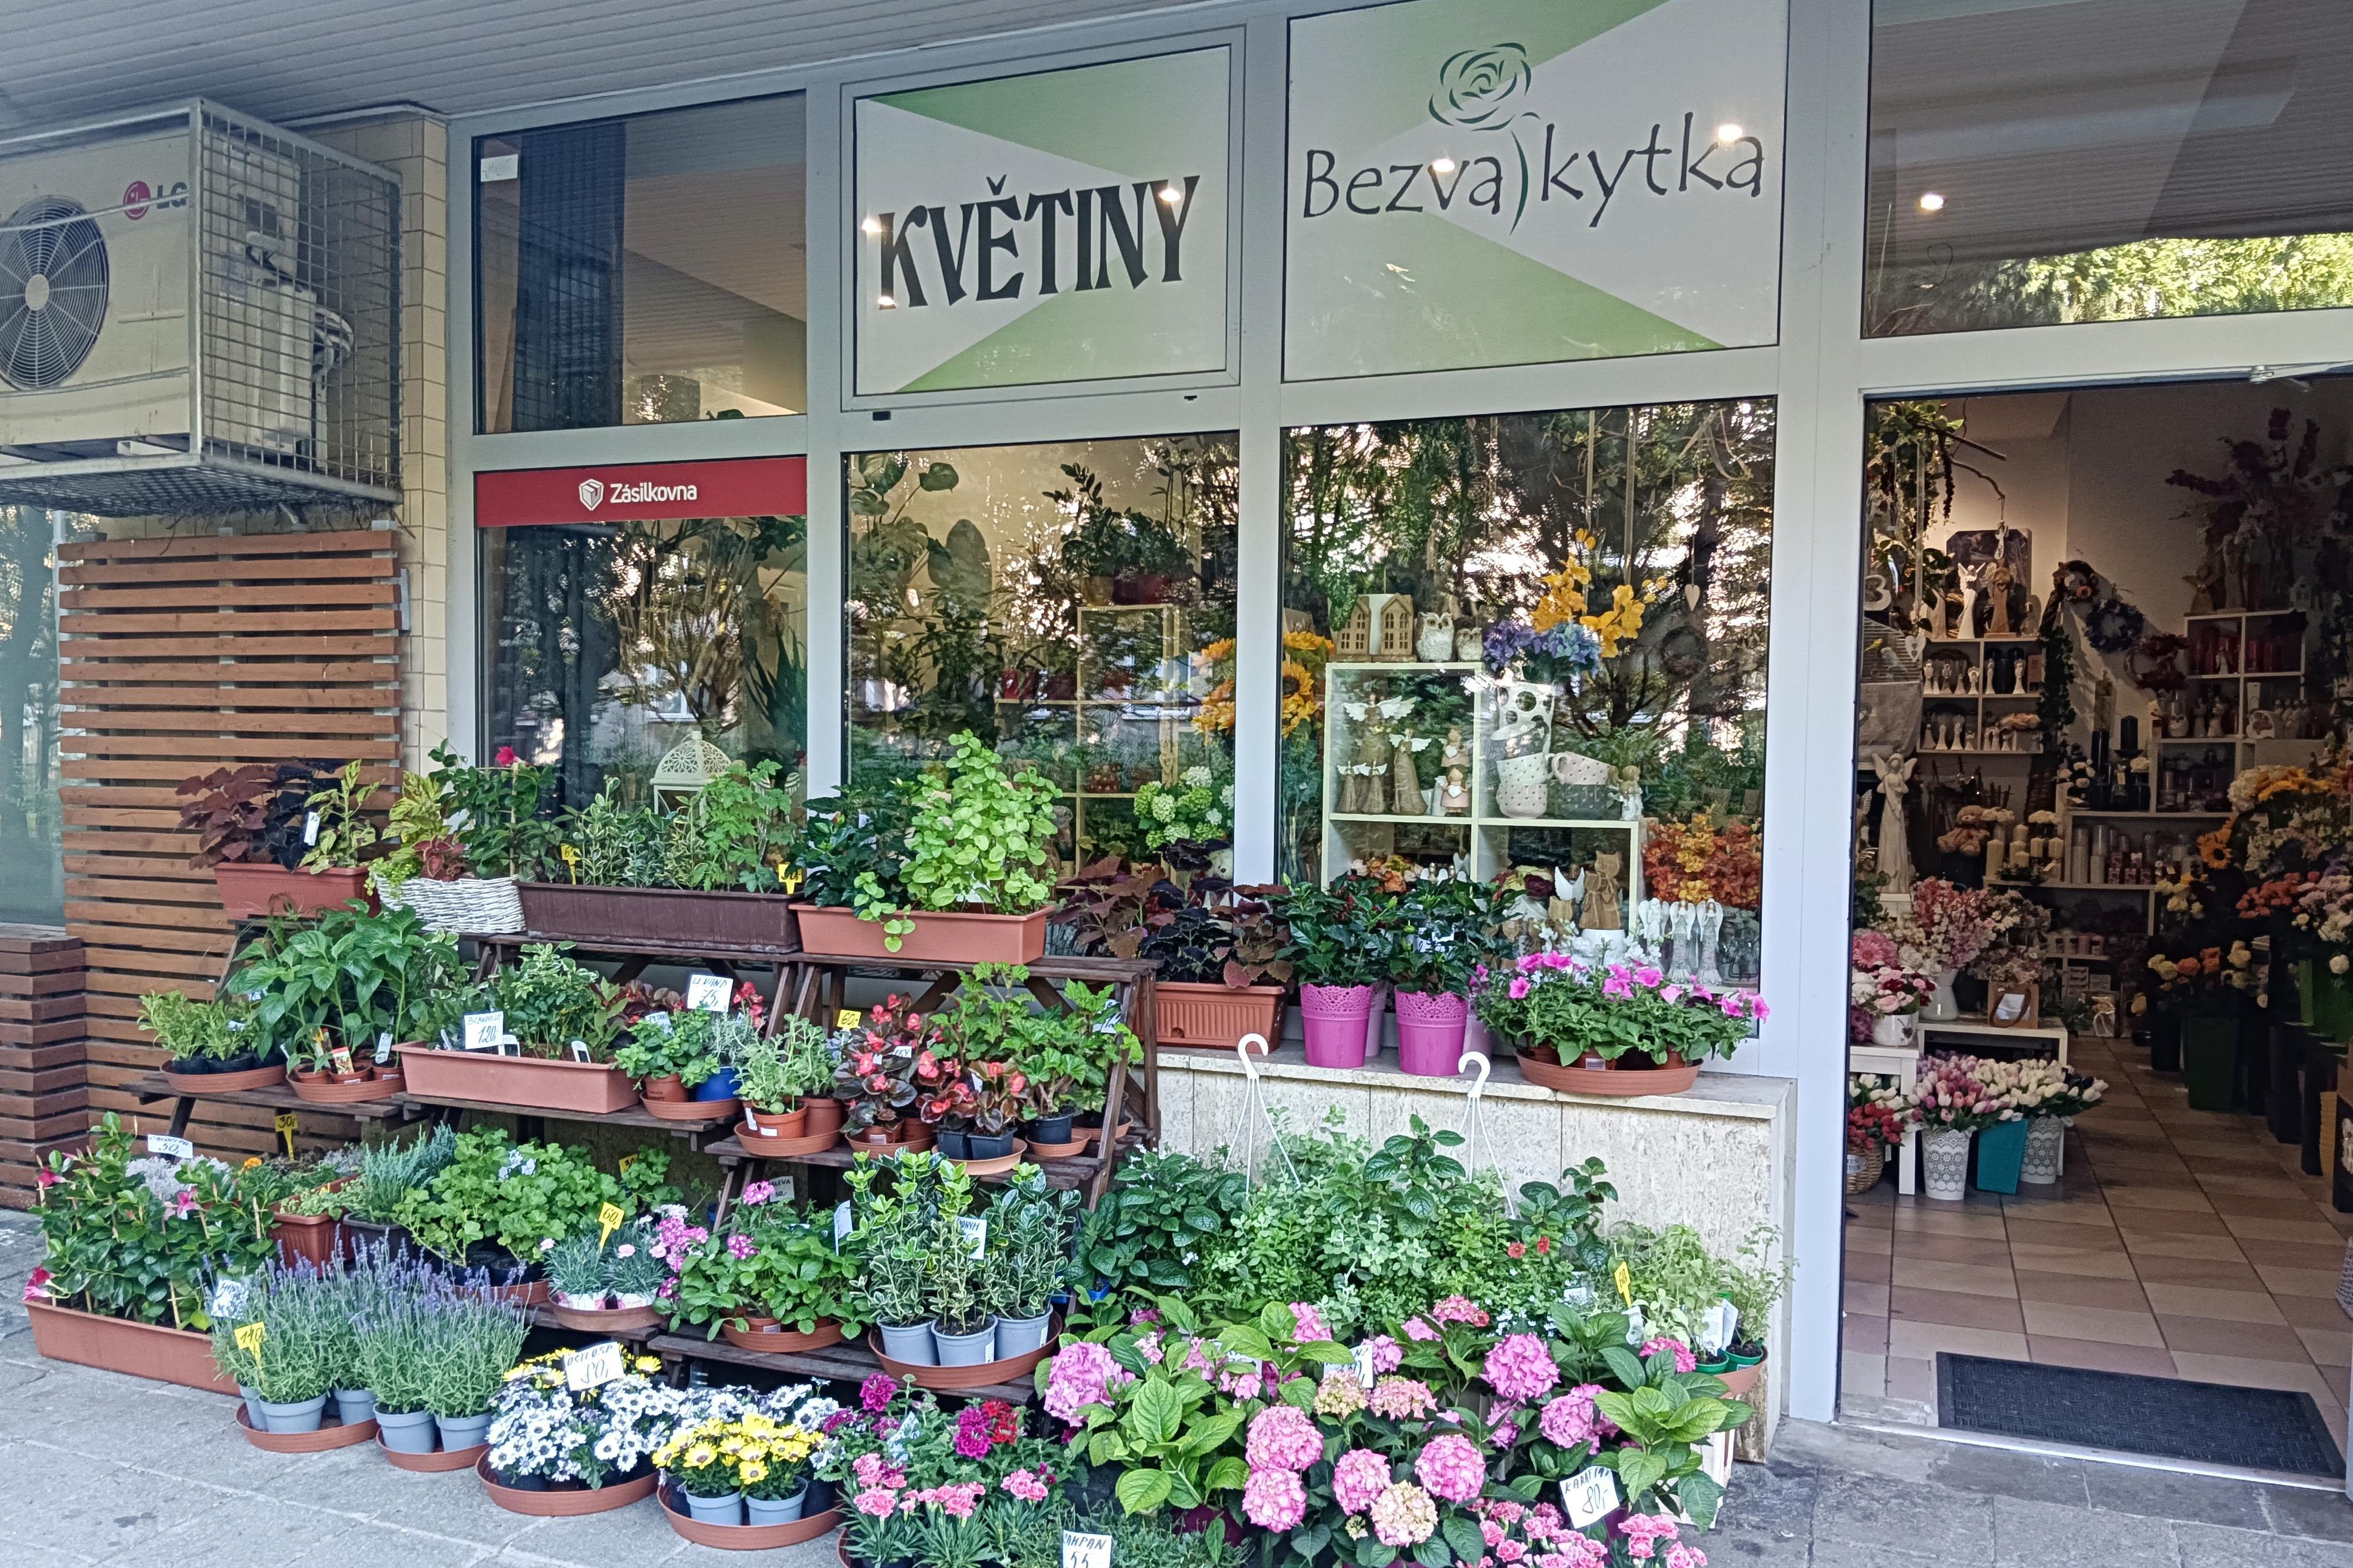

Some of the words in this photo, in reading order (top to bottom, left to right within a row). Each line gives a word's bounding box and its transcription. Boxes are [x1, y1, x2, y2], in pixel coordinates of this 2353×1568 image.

[156, 181, 187, 209] LG
[878, 174, 1201, 311] KVĚTINY
[610, 481, 697, 503] Zásilkovna
